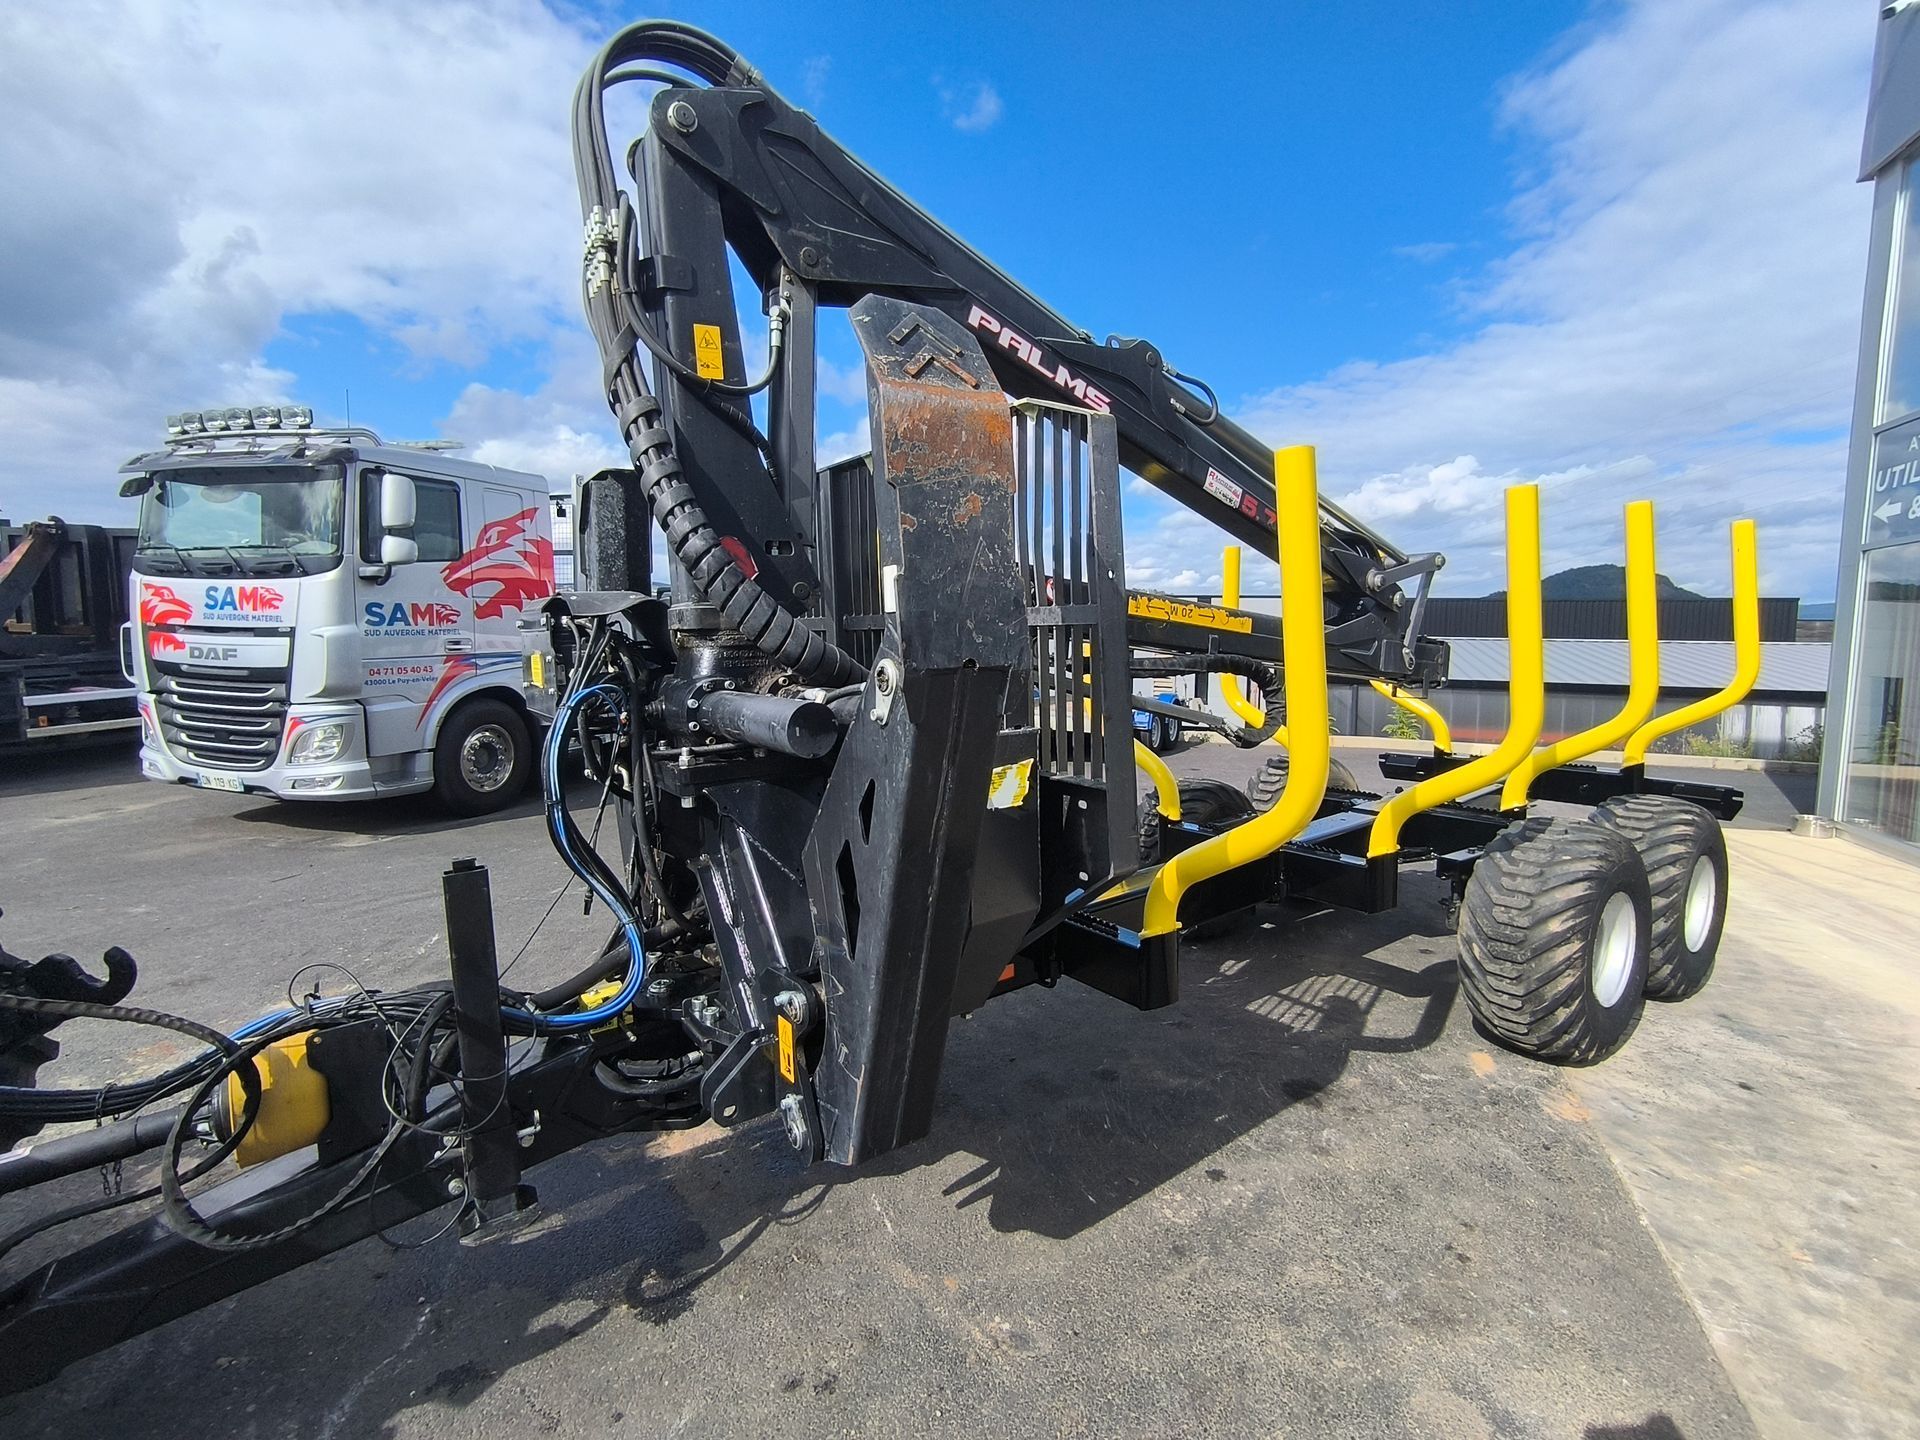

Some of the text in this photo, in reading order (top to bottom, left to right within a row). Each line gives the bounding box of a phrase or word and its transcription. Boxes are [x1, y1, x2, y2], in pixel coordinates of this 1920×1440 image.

[968, 305, 1111, 414] PALMS
[204, 585, 259, 611] SAM
[216, 613, 250, 622] AUVERGNE
[251, 614, 284, 623] MATERIEL
[365, 602, 435, 626] SAM
[427, 628, 461, 636] MATERIEL
[189, 646, 238, 660] DAF
[369, 665, 434, 676] 04 71 05 40 43
